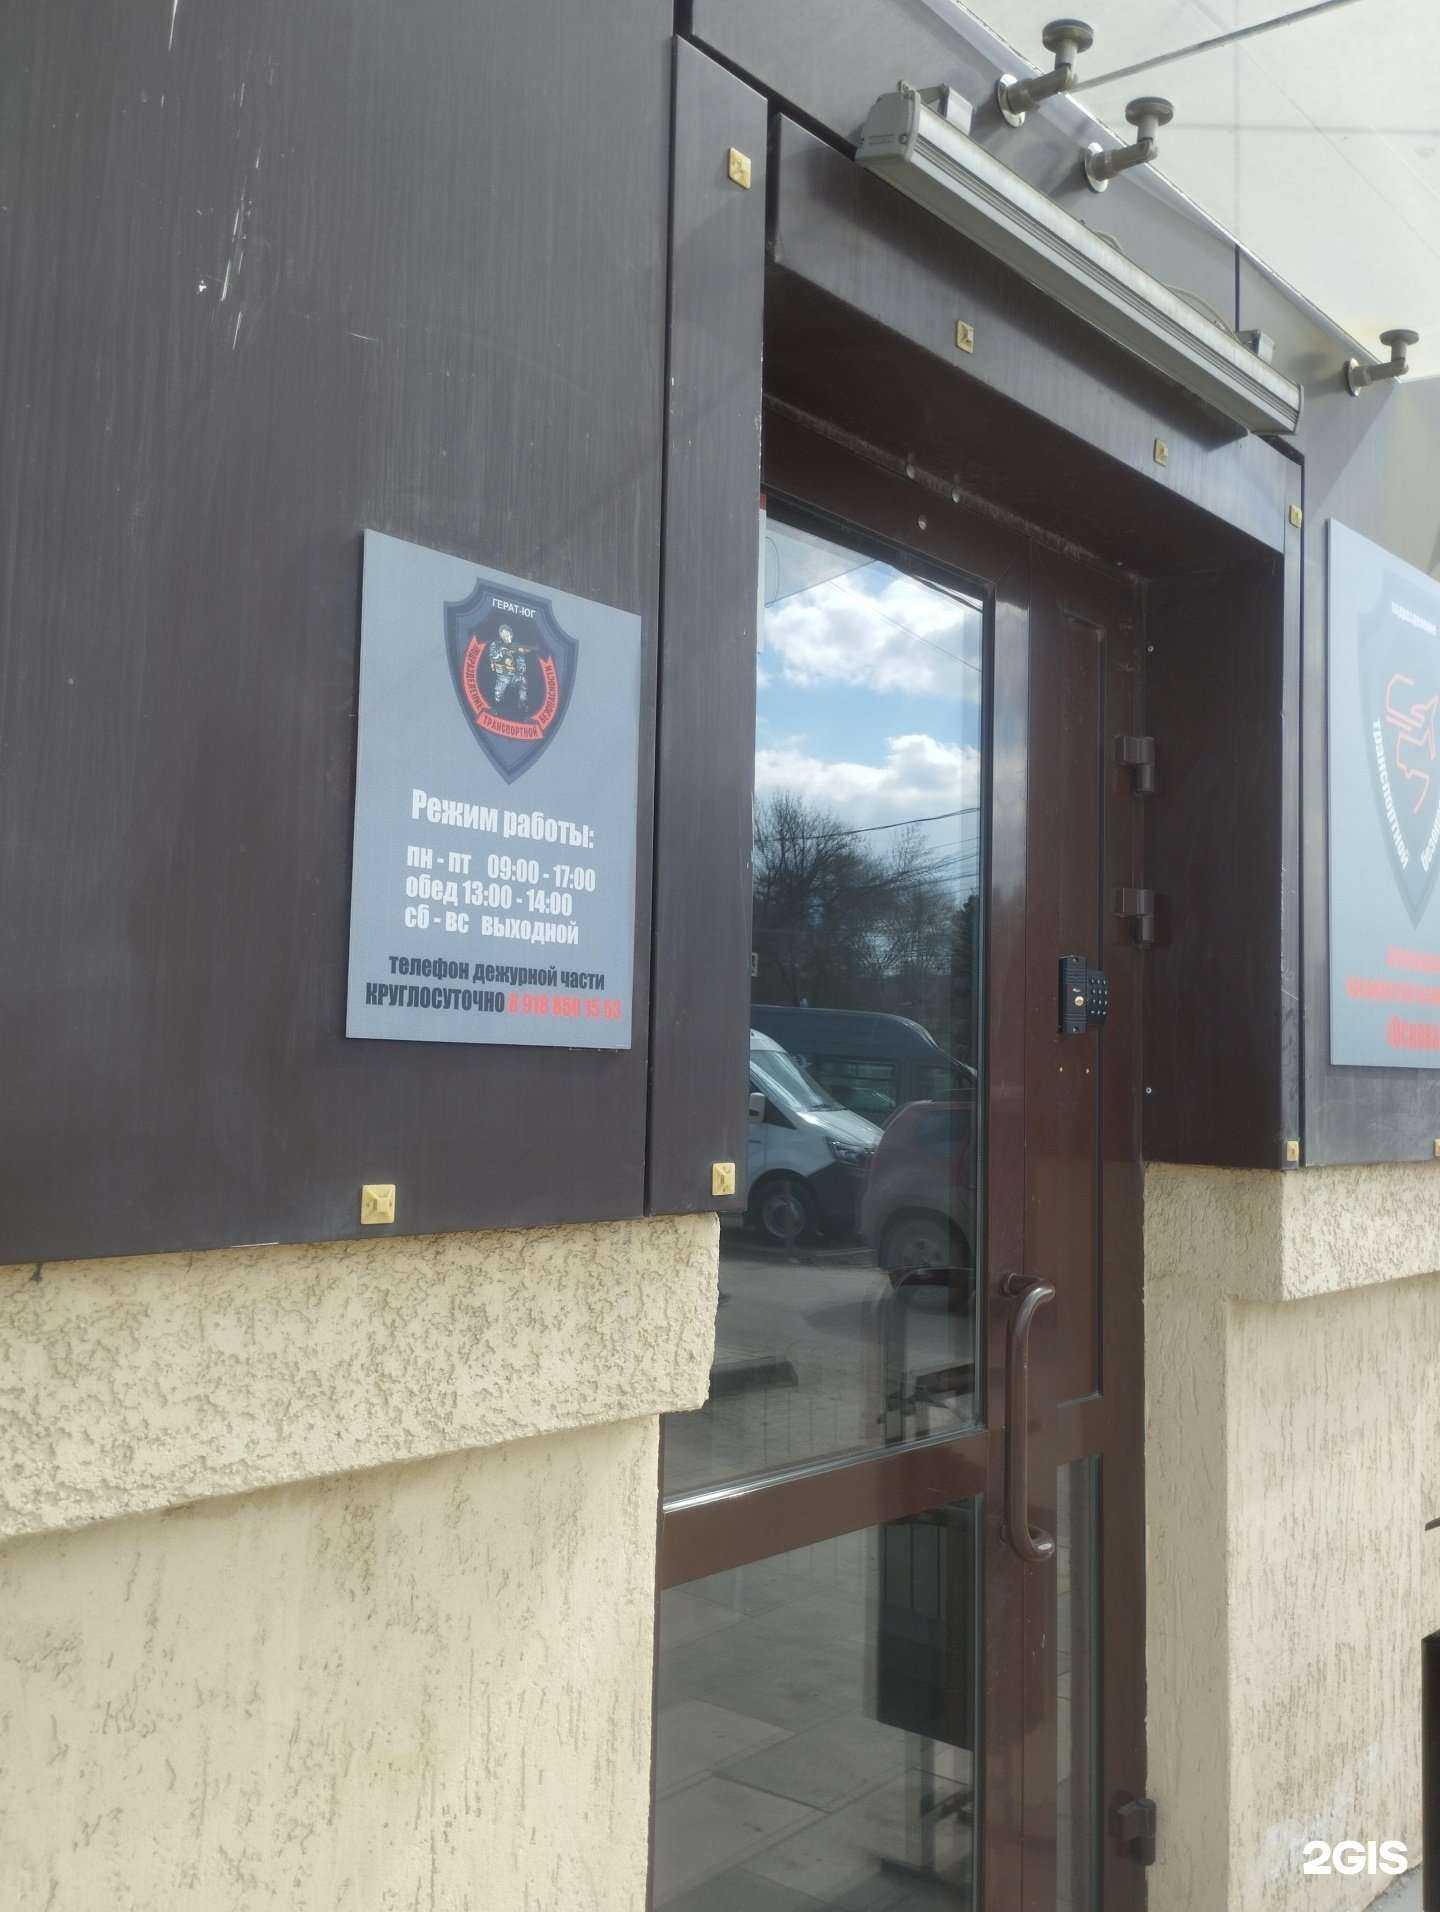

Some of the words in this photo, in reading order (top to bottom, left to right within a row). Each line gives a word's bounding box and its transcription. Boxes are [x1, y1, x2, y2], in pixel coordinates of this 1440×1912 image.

[492, 598, 536, 618] ГЕРАТ-ЮГ
[482, 715, 539, 737] ТРАНСПОРТНОЙ
[411, 788, 499, 832] Режим
[503, 810, 595, 848] работы:
[487, 854, 540, 884] 09:00
[553, 865, 596, 892] 17:00
[405, 874, 458, 906] обед
[462, 880, 513, 909] 13:00
[526, 889, 573, 917] 14:00
[481, 915, 579, 945] выходной
[388, 955, 470, 980] телефон
[472, 963, 557, 987] дежурной
[560, 970, 605, 991] части
[365, 982, 505, 1013] КРУГЛОСУТОЧНО
